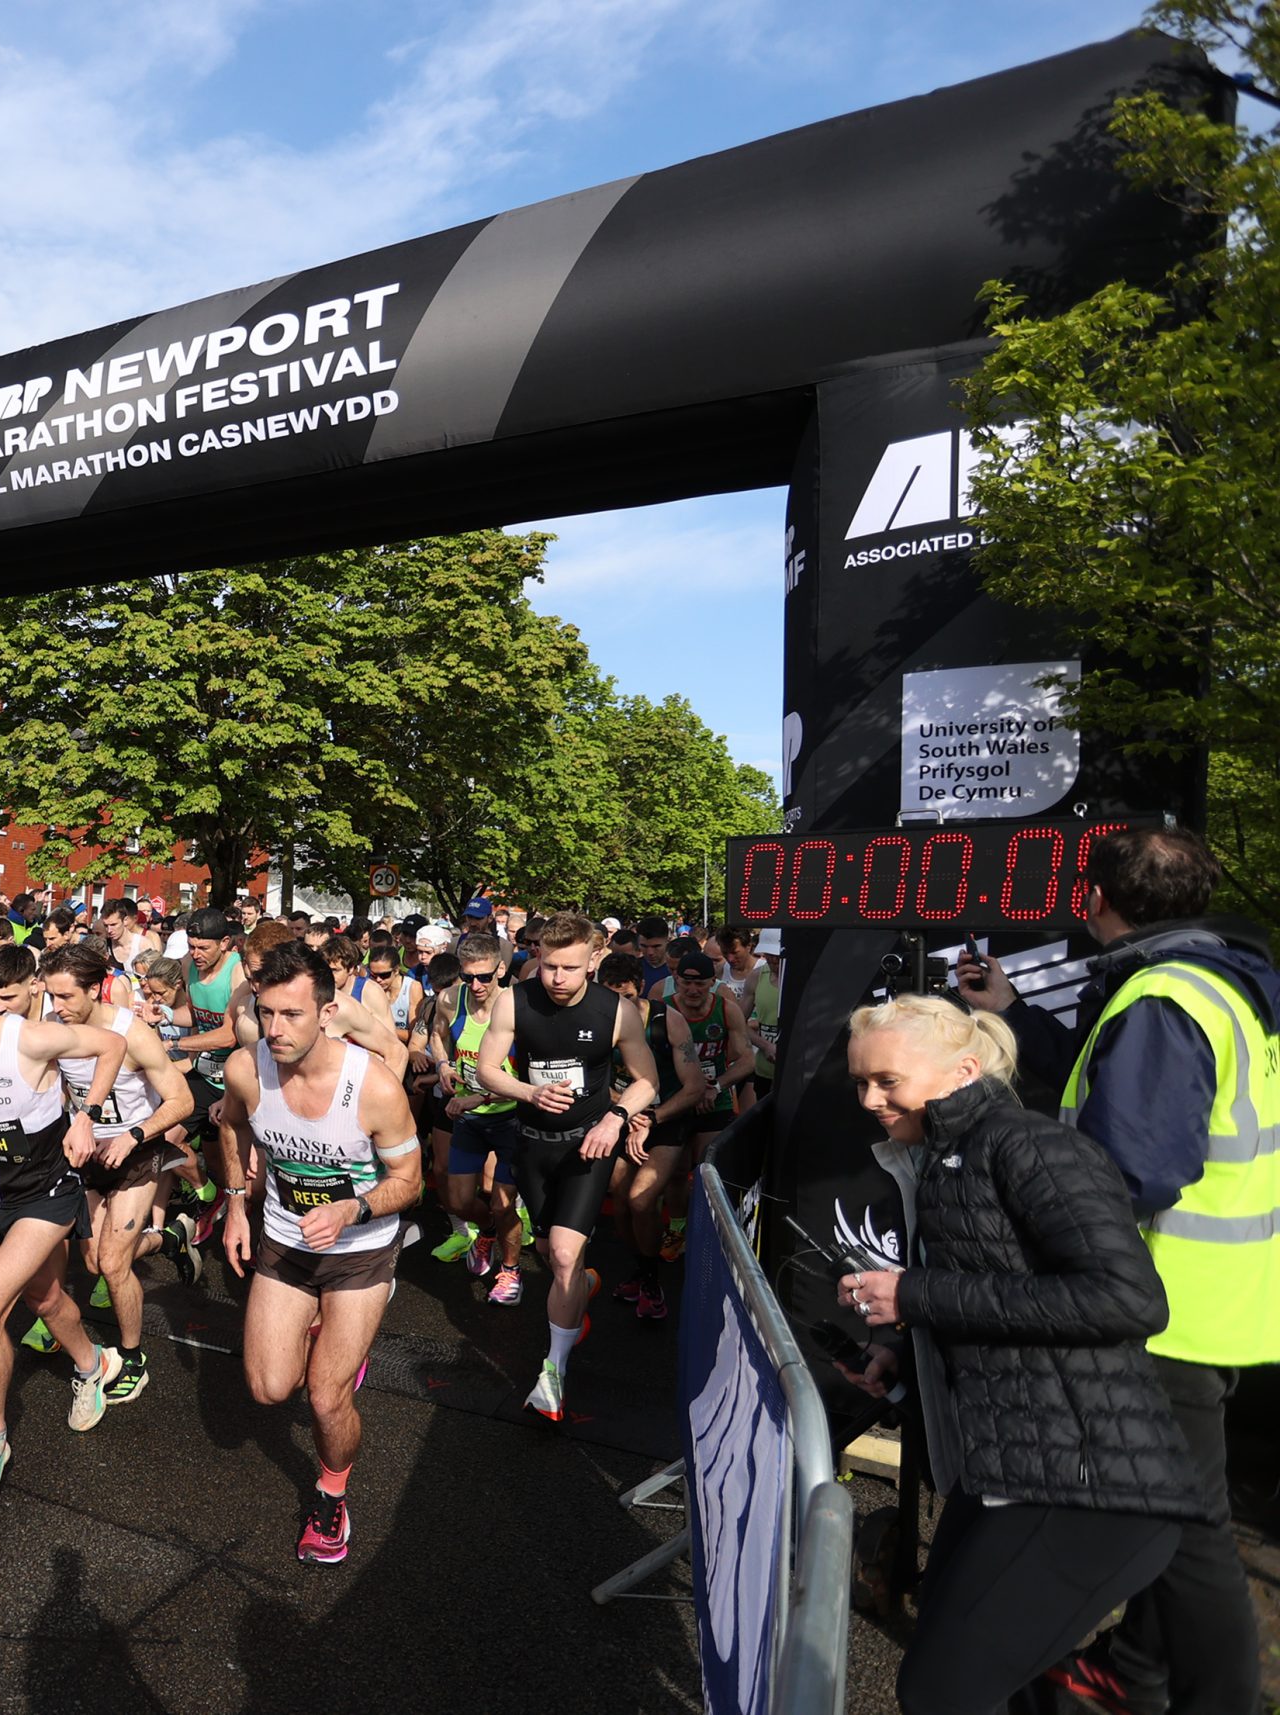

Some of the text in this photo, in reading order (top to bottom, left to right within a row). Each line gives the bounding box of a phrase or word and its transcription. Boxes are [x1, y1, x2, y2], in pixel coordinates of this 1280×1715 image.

[63, 282, 401, 406] NEWPORT
[175, 340, 398, 419] FESTIVAL
[10, 439, 172, 491] MARATHON
[177, 389, 400, 458] CASNEWYDD
[843, 532, 974, 569] ASSOCIATED
[920, 716, 1057, 738] University of
[919, 739, 1050, 759] South Wales
[919, 760, 1011, 782] Prifysgol
[919, 784, 1022, 803] De Cymru
[374, 873, 395, 886] 20
[540, 1071, 569, 1079] ELLIOT
[341, 1079, 355, 1108] soar
[262, 1128, 346, 1157] SWANSEA
[292, 1189, 332, 1207] REES
